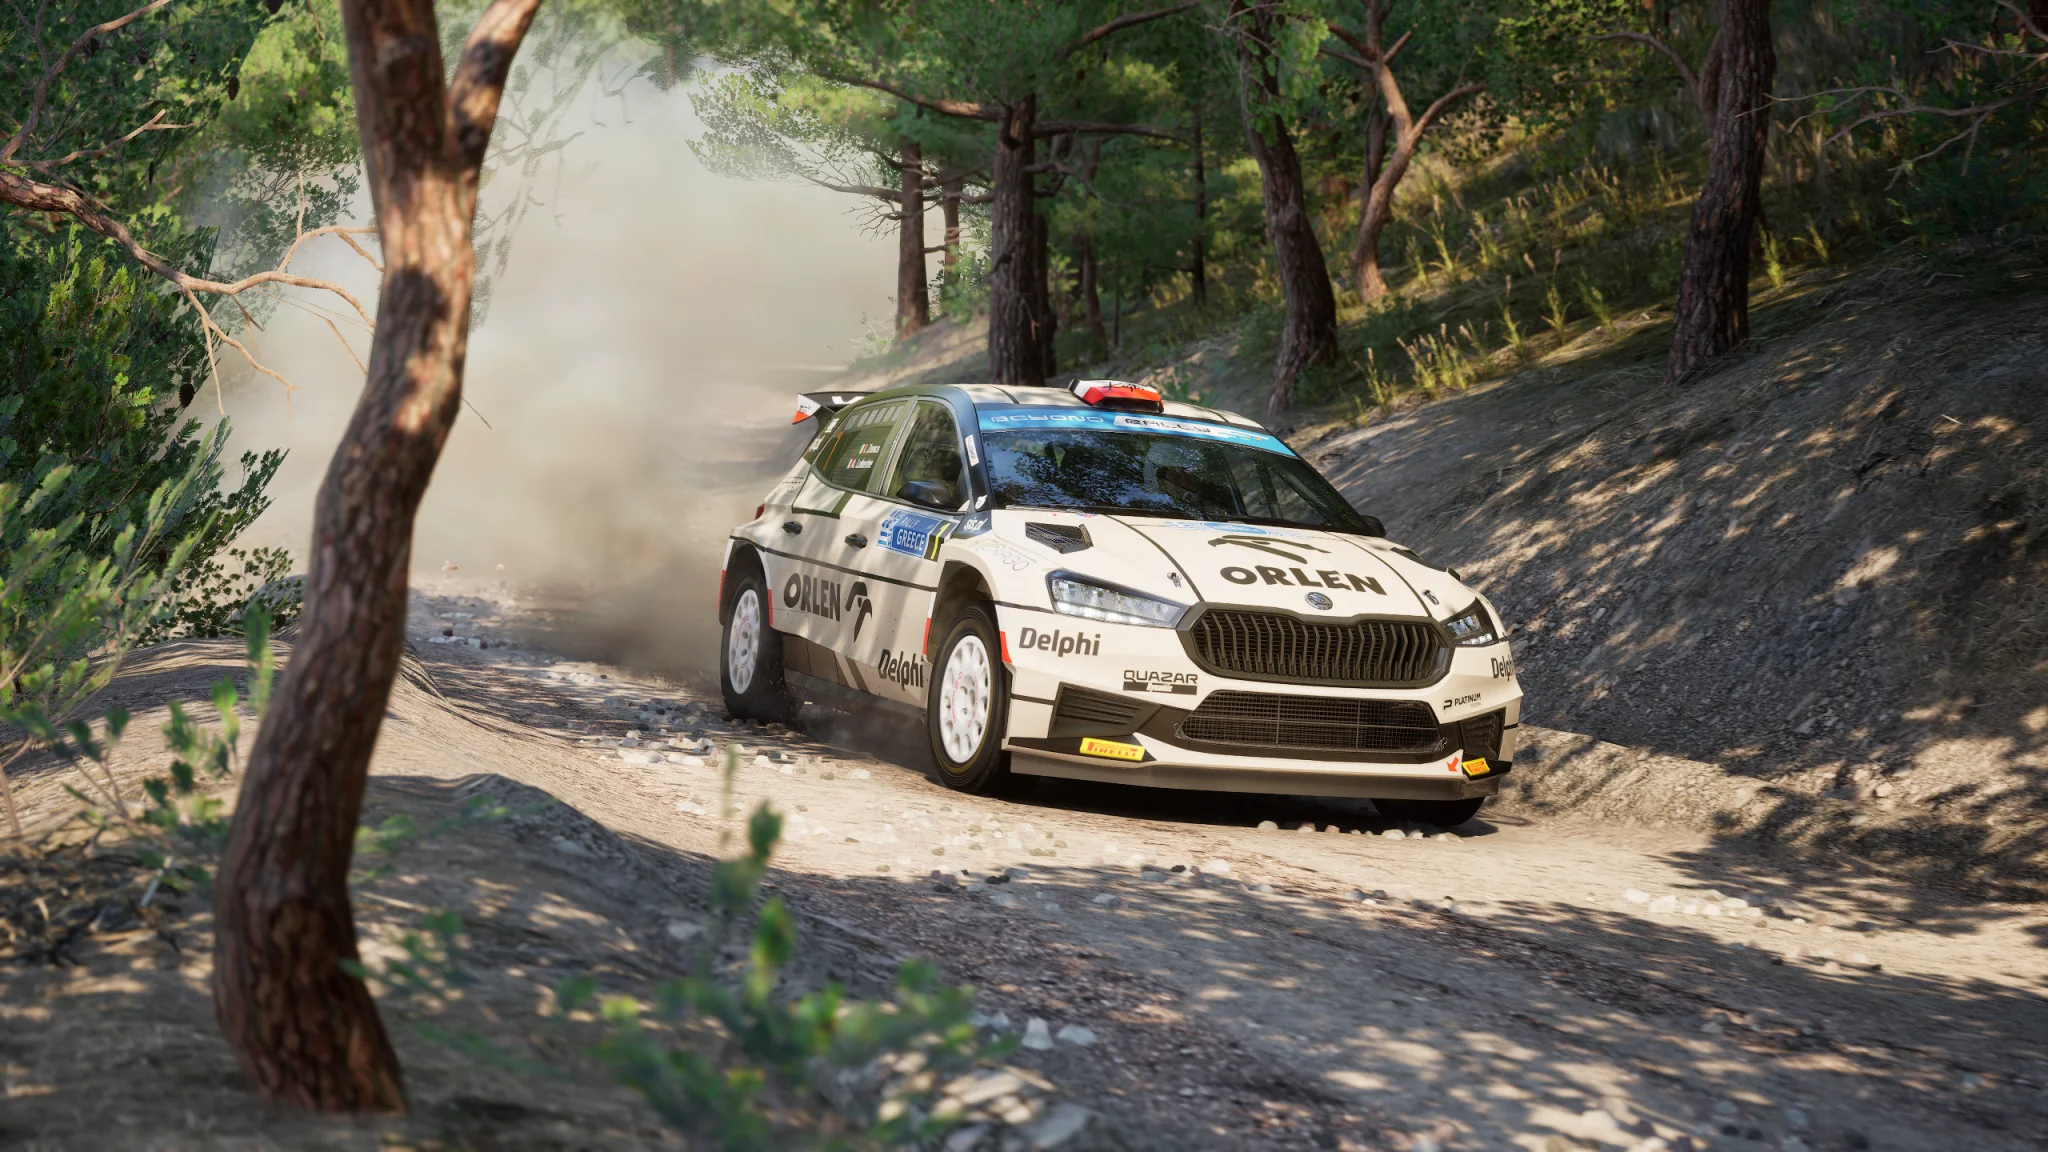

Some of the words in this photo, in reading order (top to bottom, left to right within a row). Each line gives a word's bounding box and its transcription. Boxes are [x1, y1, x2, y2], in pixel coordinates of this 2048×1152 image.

[1124, 418, 1211, 434] RALLY
[896, 528, 926, 551] GREECE
[1219, 564, 1388, 596] ORLEN
[783, 572, 841, 622] ORLEN
[1018, 626, 1101, 658] Delphi
[877, 648, 924, 692] Delphi
[1123, 669, 1199, 685] QUAZAR
[1454, 692, 1482, 707] PLATINUM
[1087, 741, 1138, 757] PIRELLI
